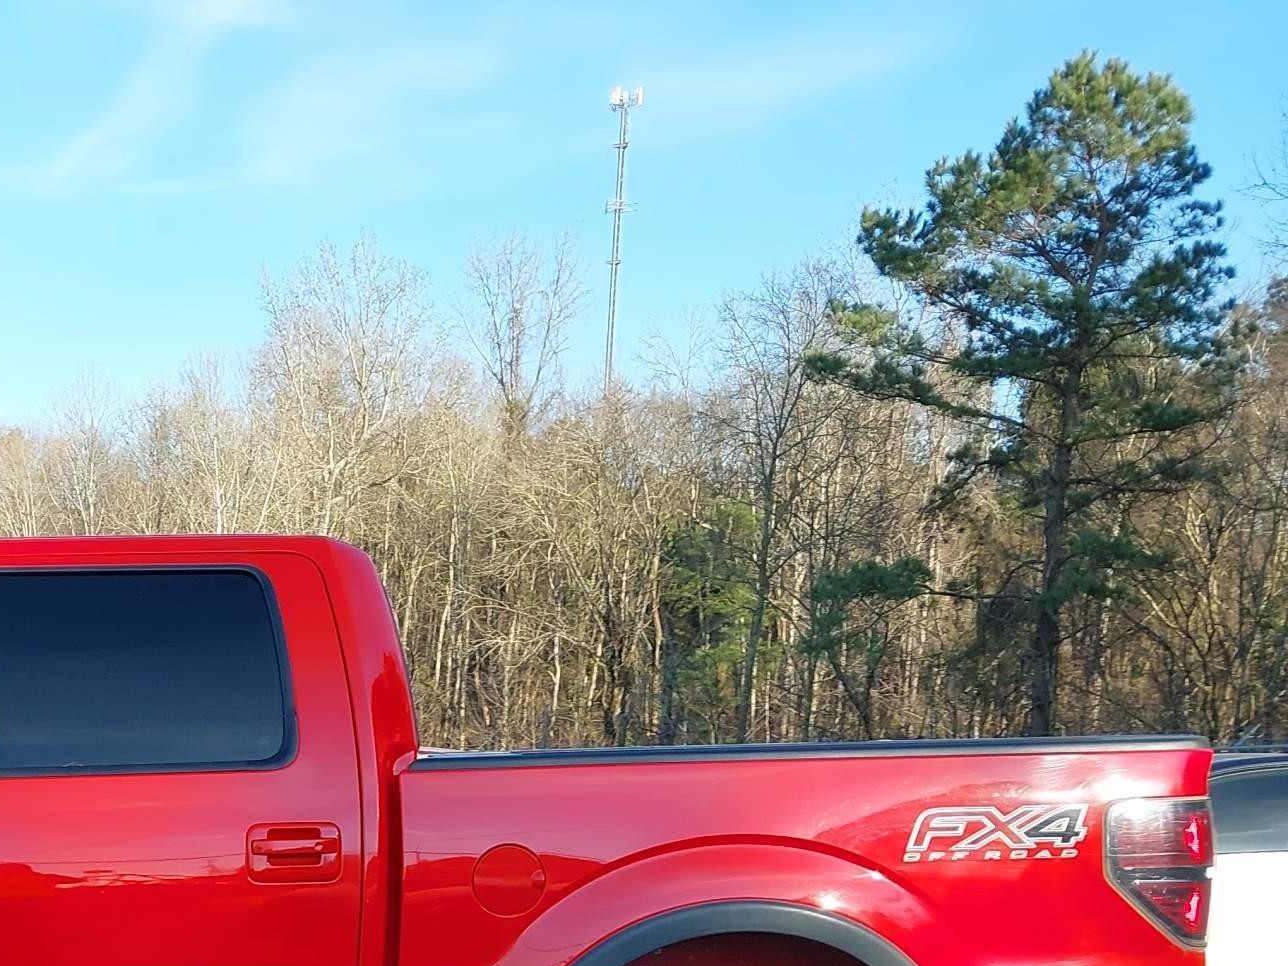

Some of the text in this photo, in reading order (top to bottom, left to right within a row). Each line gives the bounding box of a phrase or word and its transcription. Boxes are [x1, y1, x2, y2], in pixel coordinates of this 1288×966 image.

[906, 803, 1089, 851] FX4
[903, 848, 1079, 862] OFF ROAD
